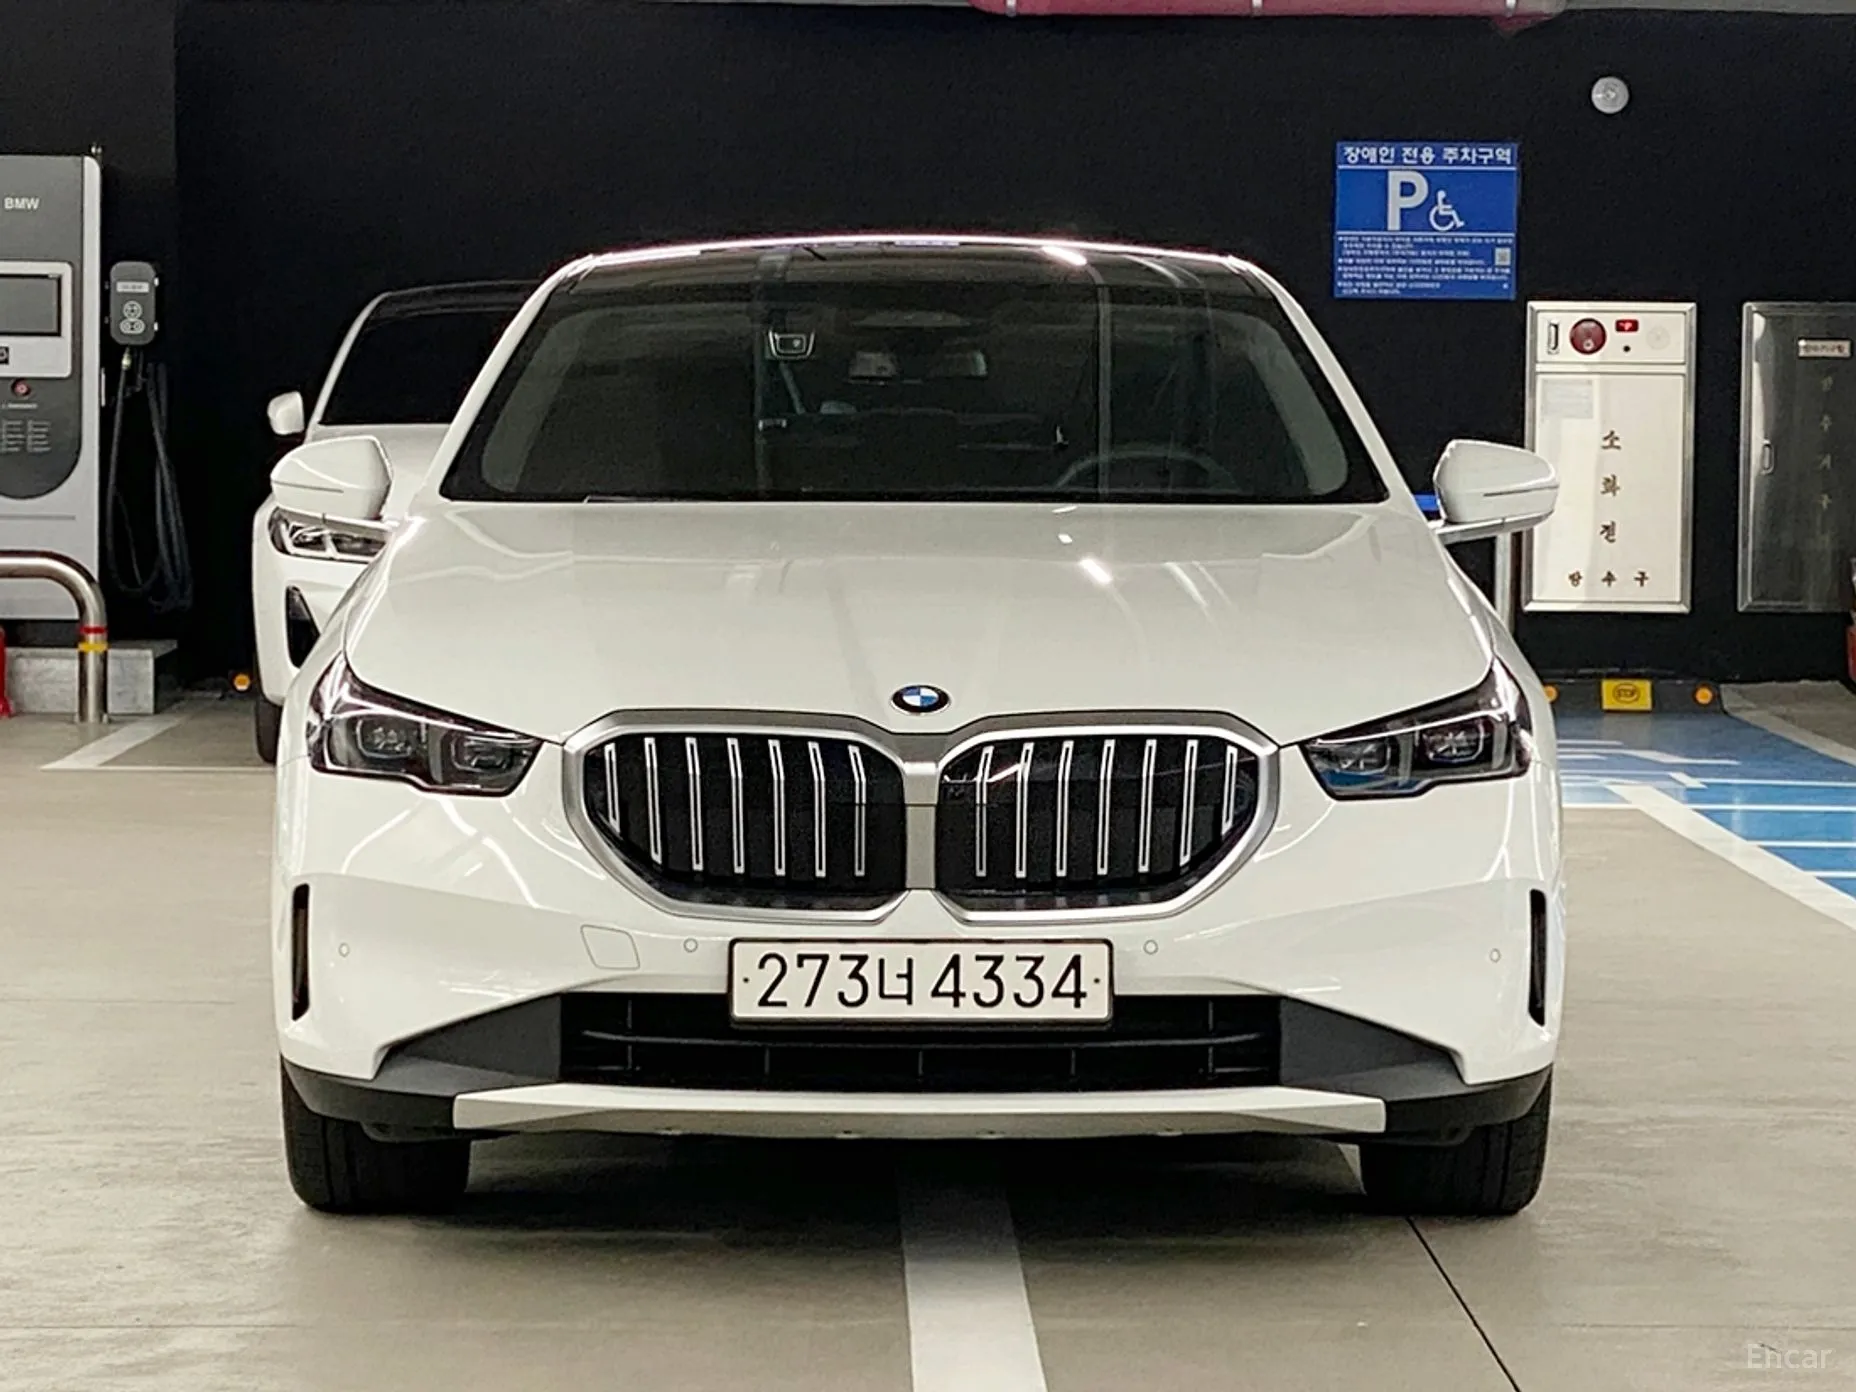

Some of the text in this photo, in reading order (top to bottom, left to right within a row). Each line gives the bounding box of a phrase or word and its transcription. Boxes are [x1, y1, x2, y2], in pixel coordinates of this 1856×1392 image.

[1344, 147, 1510, 164] 장애인 전용 주차구역
[4, 197, 40, 209] BMW
[1387, 171, 1428, 230] P
[757, 953, 1087, 1008] 273너 4334
